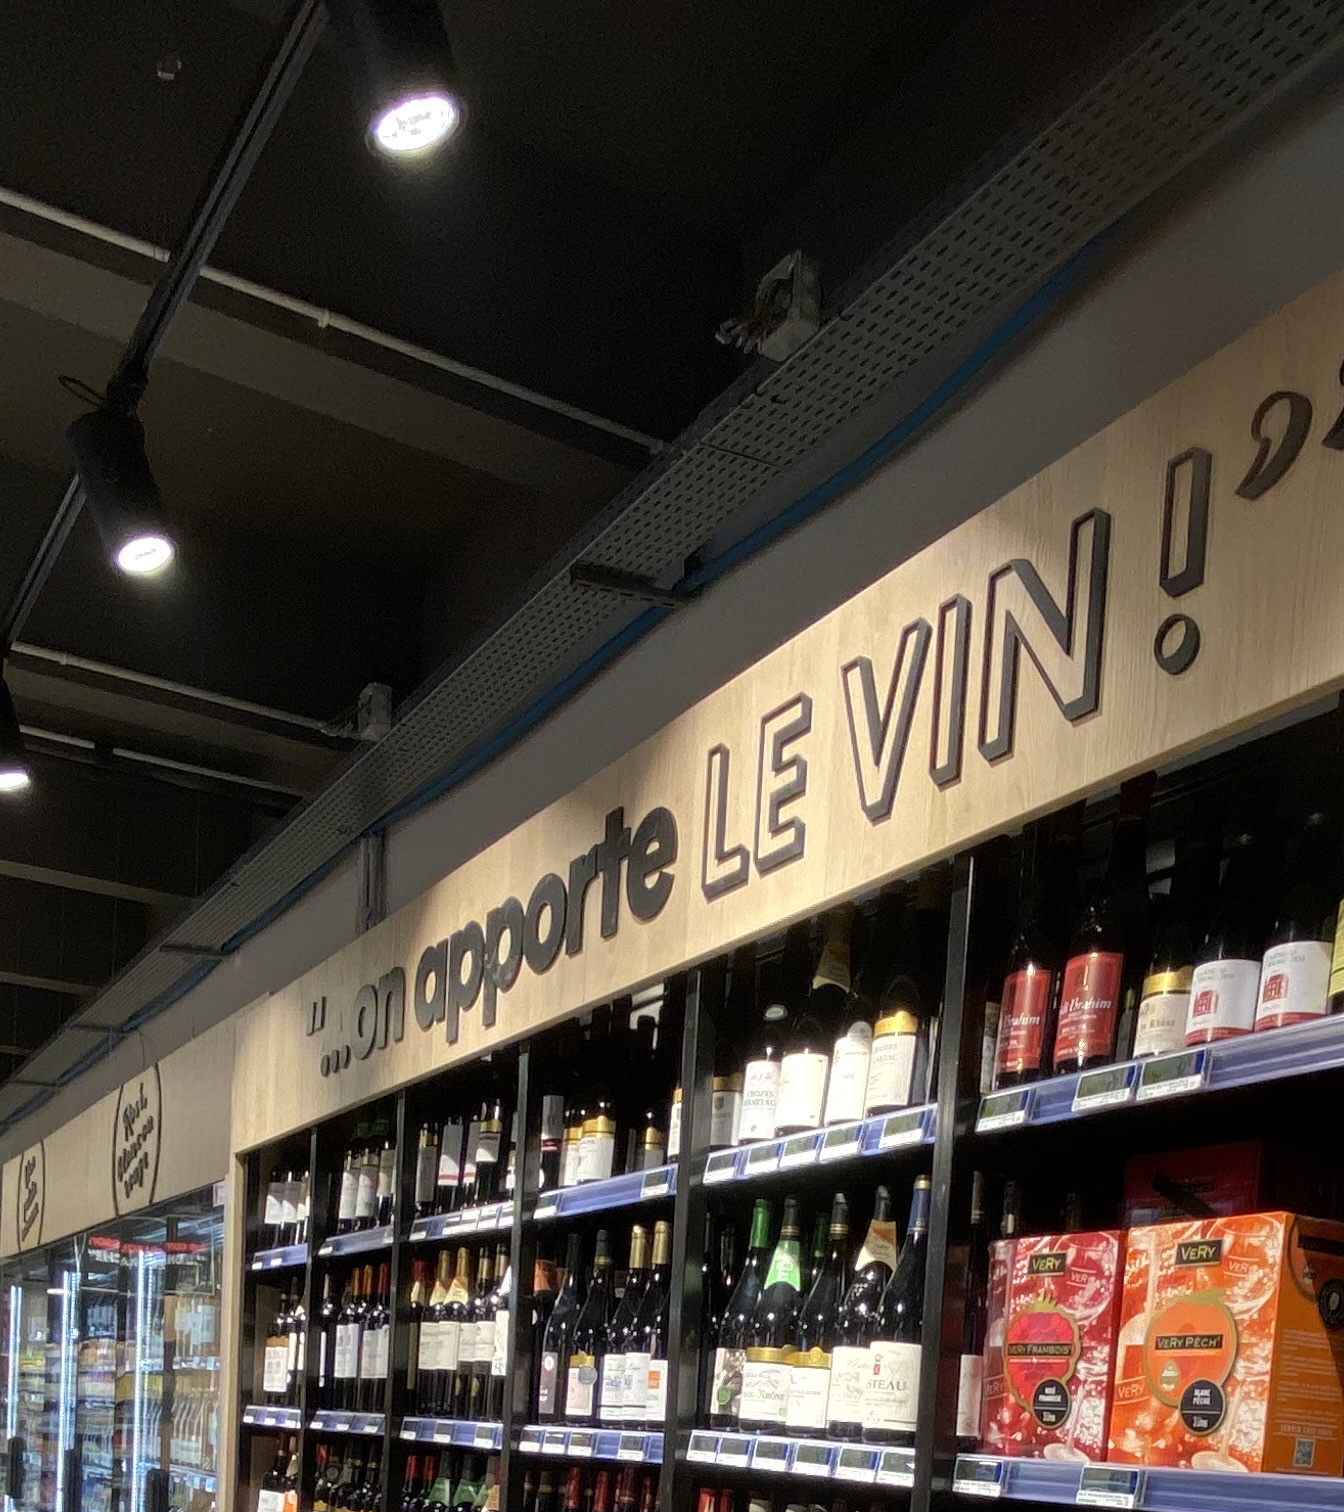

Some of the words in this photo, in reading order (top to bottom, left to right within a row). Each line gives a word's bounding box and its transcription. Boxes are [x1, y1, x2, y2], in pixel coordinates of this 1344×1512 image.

[414, 806, 678, 1046] apporte
[701, 692, 812, 900] LE
[841, 508, 1111, 825] VIN
[1181, 1246, 1216, 1260] VERY
[1032, 1257, 1061, 1271] VERY
